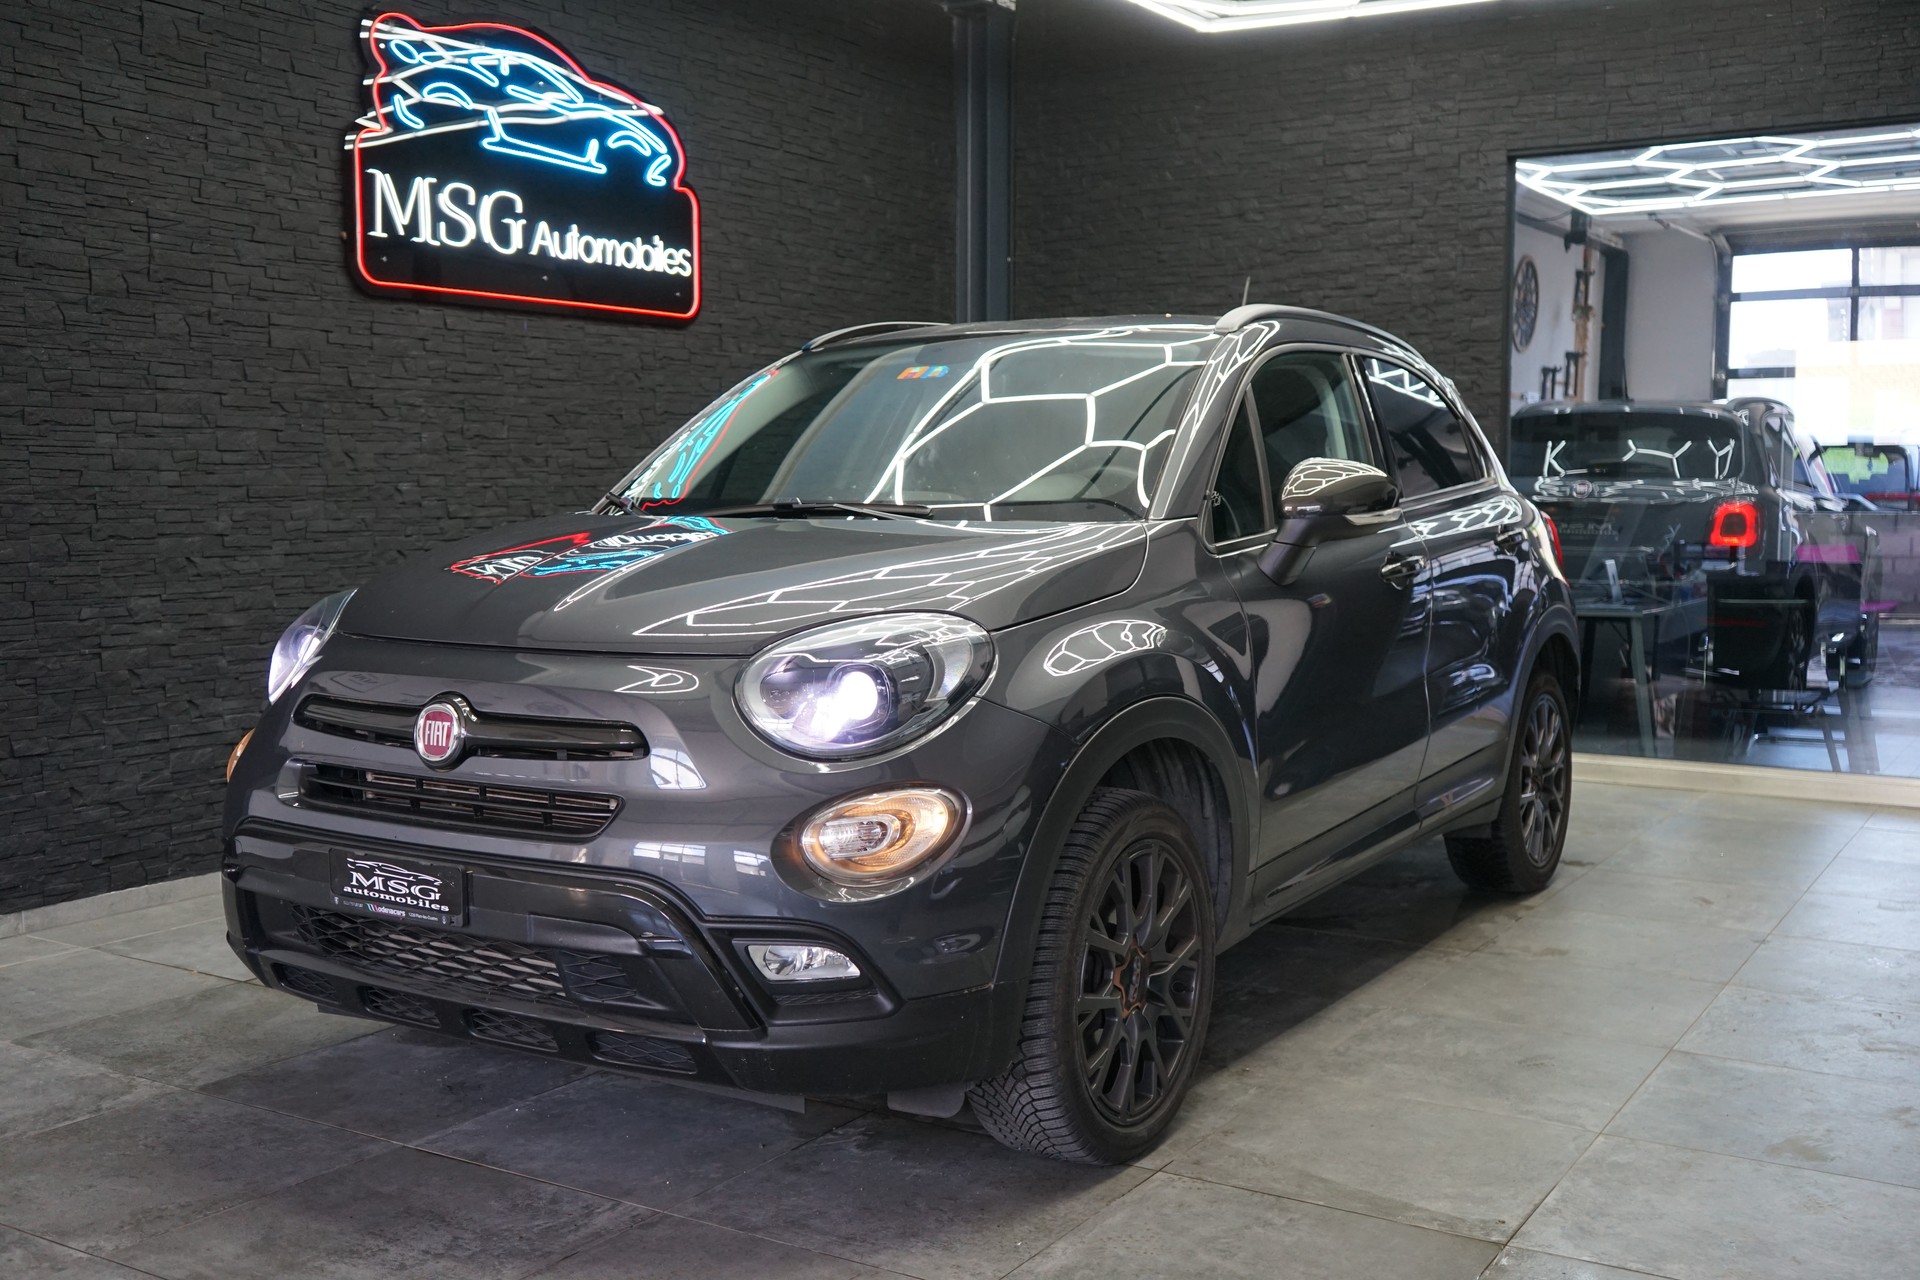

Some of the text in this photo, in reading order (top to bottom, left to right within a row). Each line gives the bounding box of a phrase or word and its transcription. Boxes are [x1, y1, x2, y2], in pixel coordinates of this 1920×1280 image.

[365, 168, 692, 277] MSG Automobiles
[424, 720, 451, 747] FIAT
[343, 885, 450, 912] automobiles
[349, 871, 442, 900] MSG
